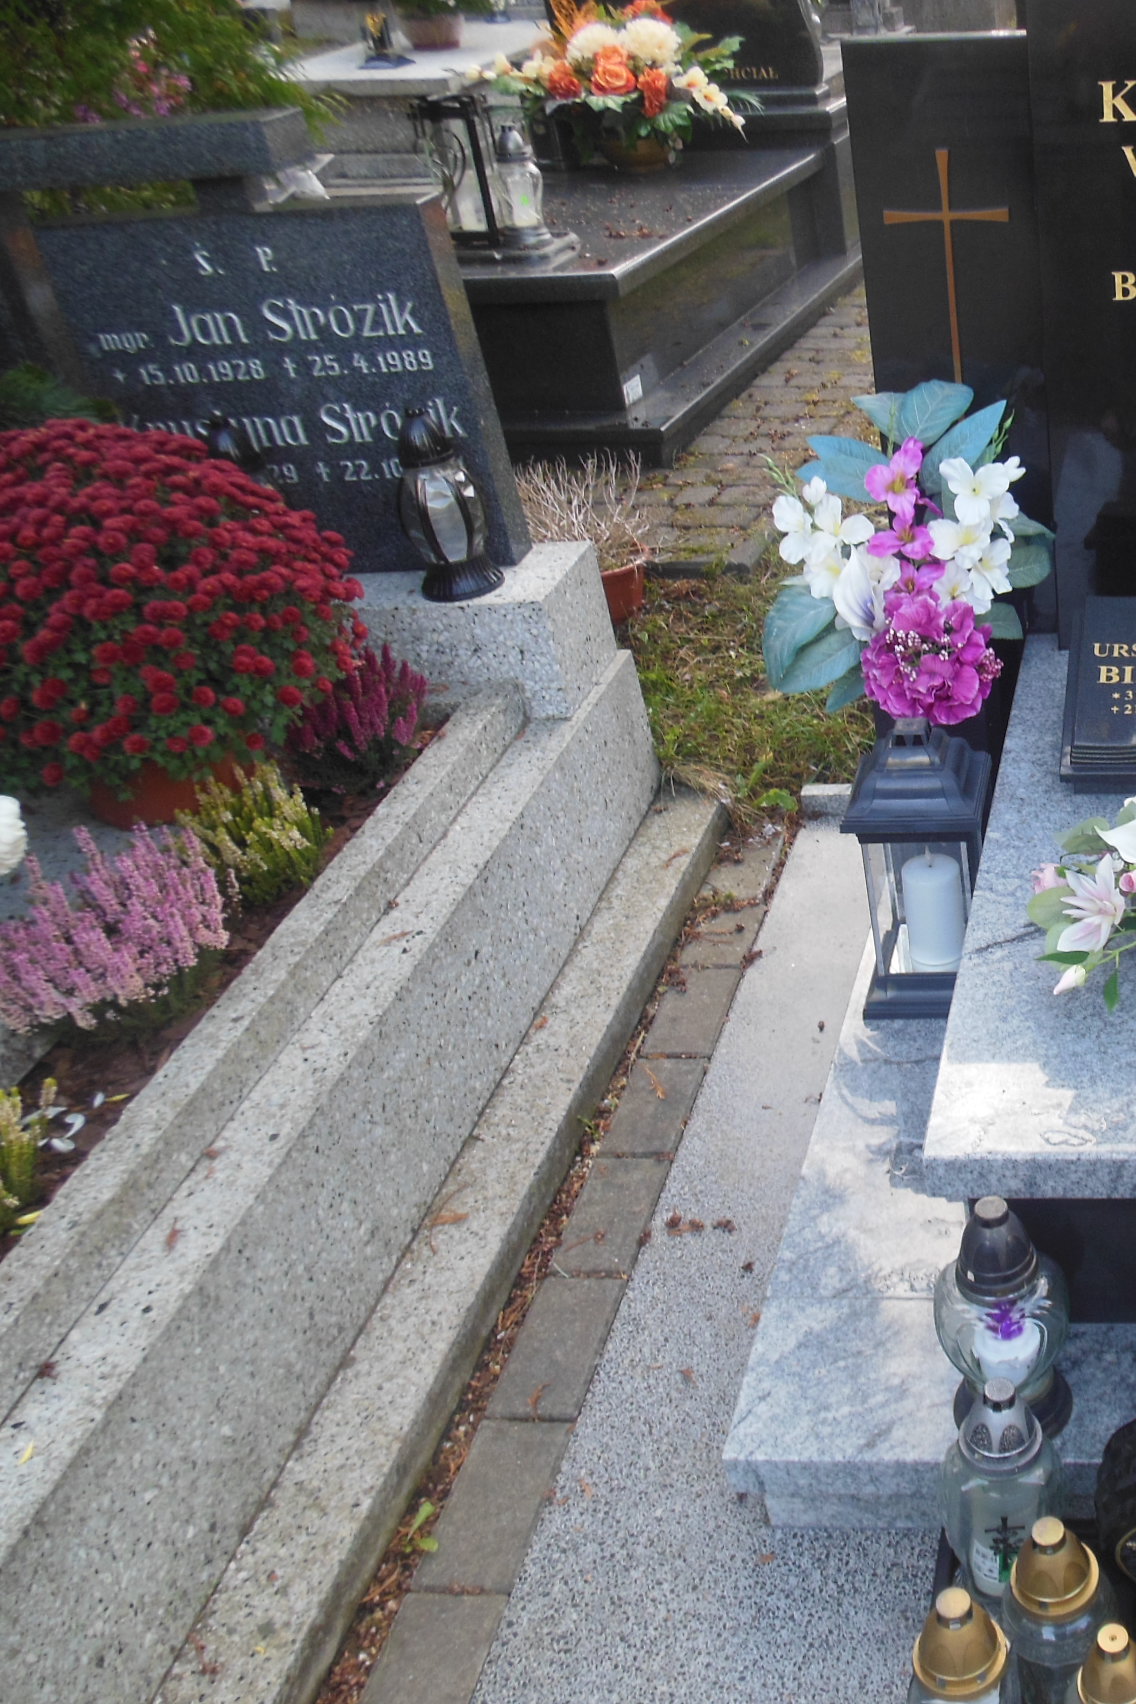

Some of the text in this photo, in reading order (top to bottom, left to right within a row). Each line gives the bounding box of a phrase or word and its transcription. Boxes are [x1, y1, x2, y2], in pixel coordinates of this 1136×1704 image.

[168, 304, 250, 347] Jan
[138, 349, 434, 386] 15.10.1928 25.4.1989
